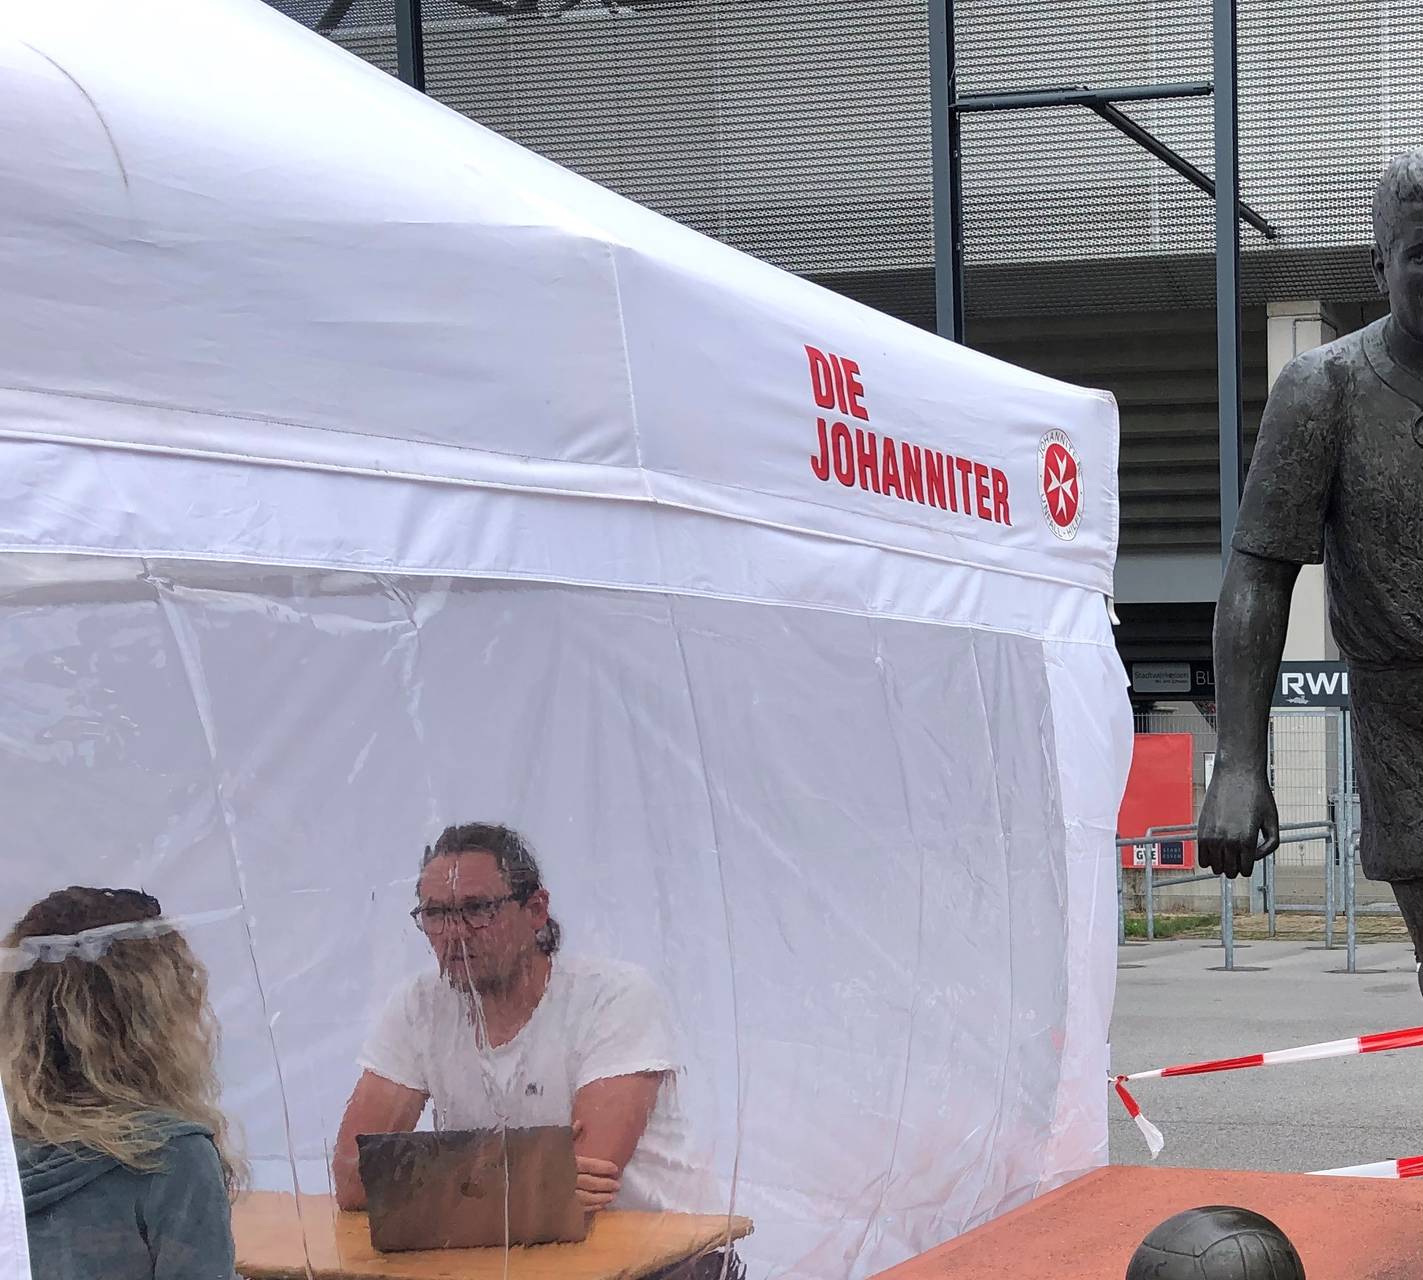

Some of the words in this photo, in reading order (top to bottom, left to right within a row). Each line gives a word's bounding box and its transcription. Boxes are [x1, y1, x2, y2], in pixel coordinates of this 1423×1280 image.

[804, 344, 869, 421] DIE
[810, 417, 1013, 526] JOHANNITER
[1136, 850, 1157, 860] GE
